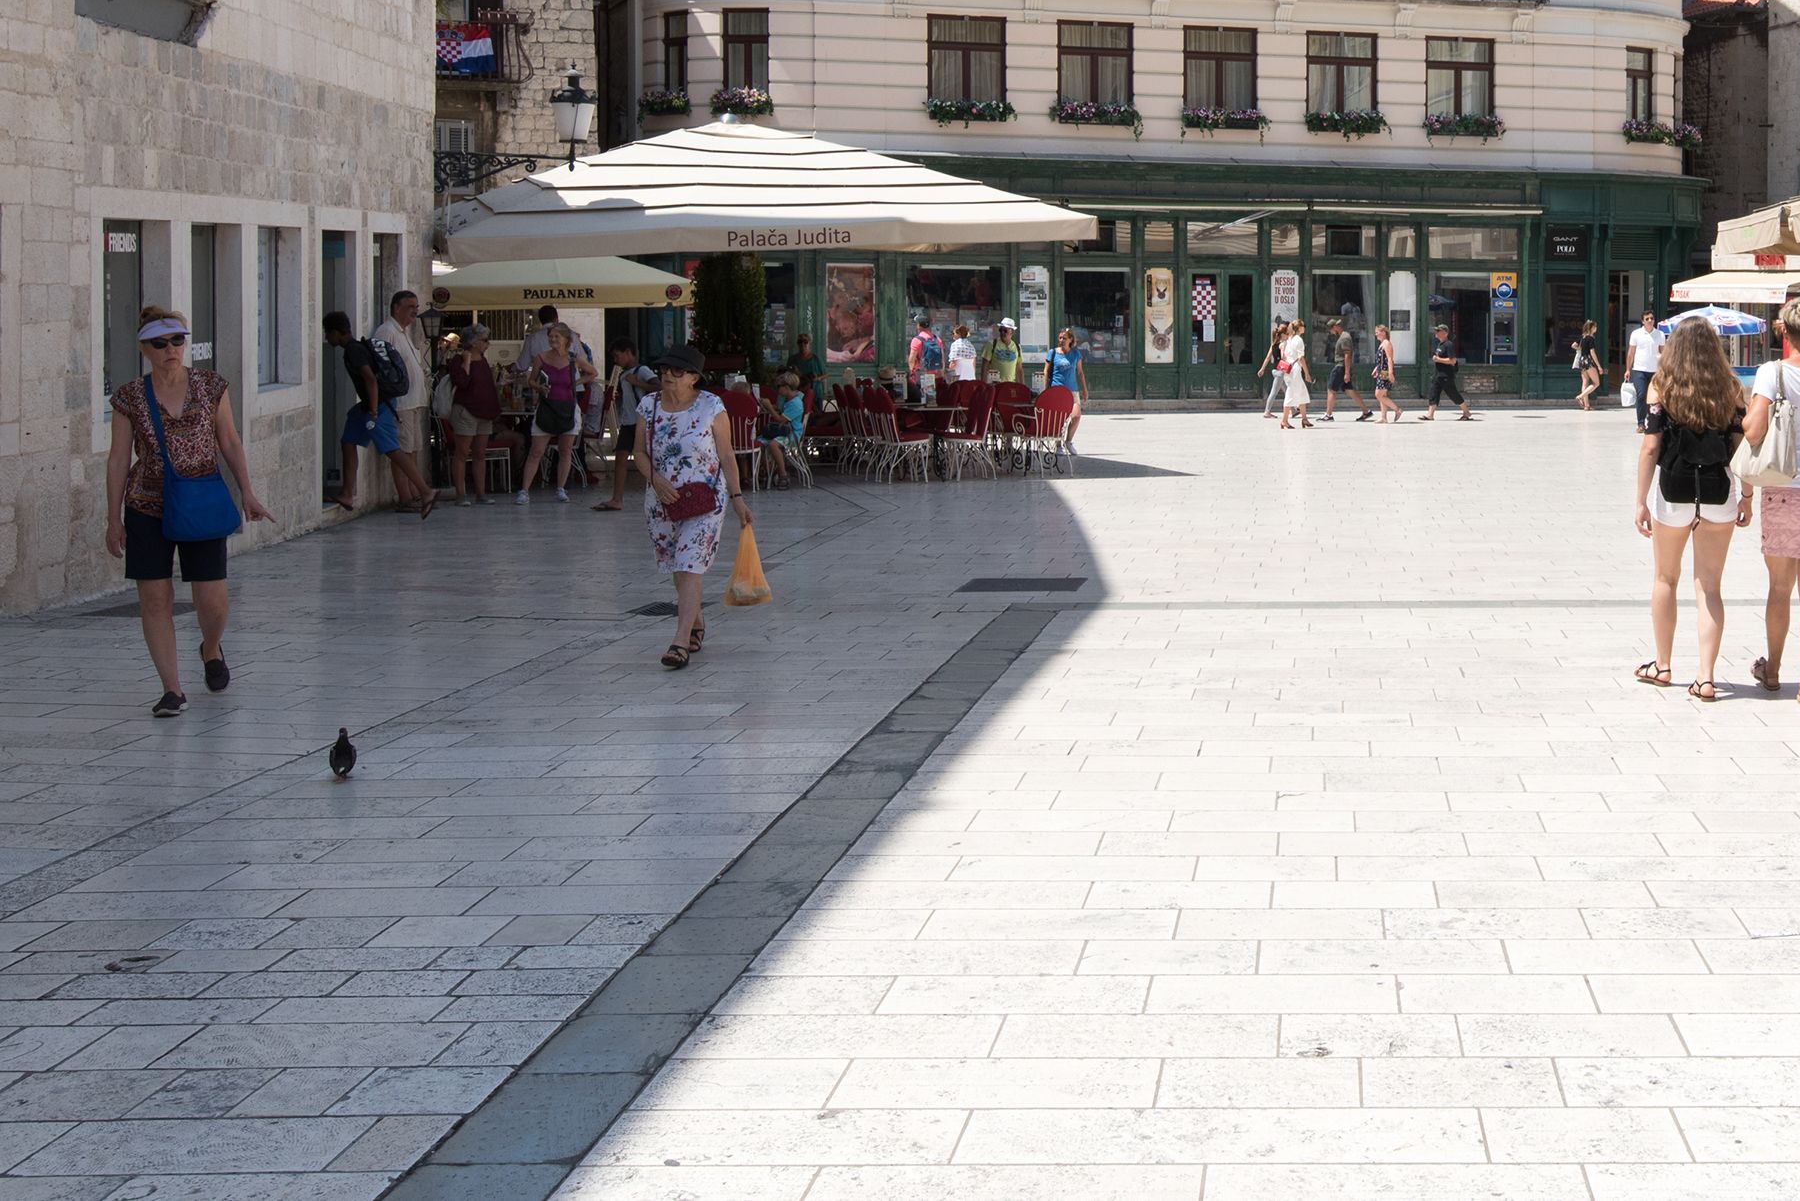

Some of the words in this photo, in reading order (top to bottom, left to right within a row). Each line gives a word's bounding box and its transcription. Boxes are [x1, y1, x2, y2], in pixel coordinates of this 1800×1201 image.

[727, 228, 788, 247] Palača
[795, 227, 851, 246] Judita
[108, 232, 137, 253] FRIENDS
[1556, 245, 1576, 253] POLO
[523, 288, 595, 300] PAULANER
[1274, 286, 1281, 295] TE
[1274, 295, 1280, 304] U
[1280, 295, 1296, 304] OSLO
